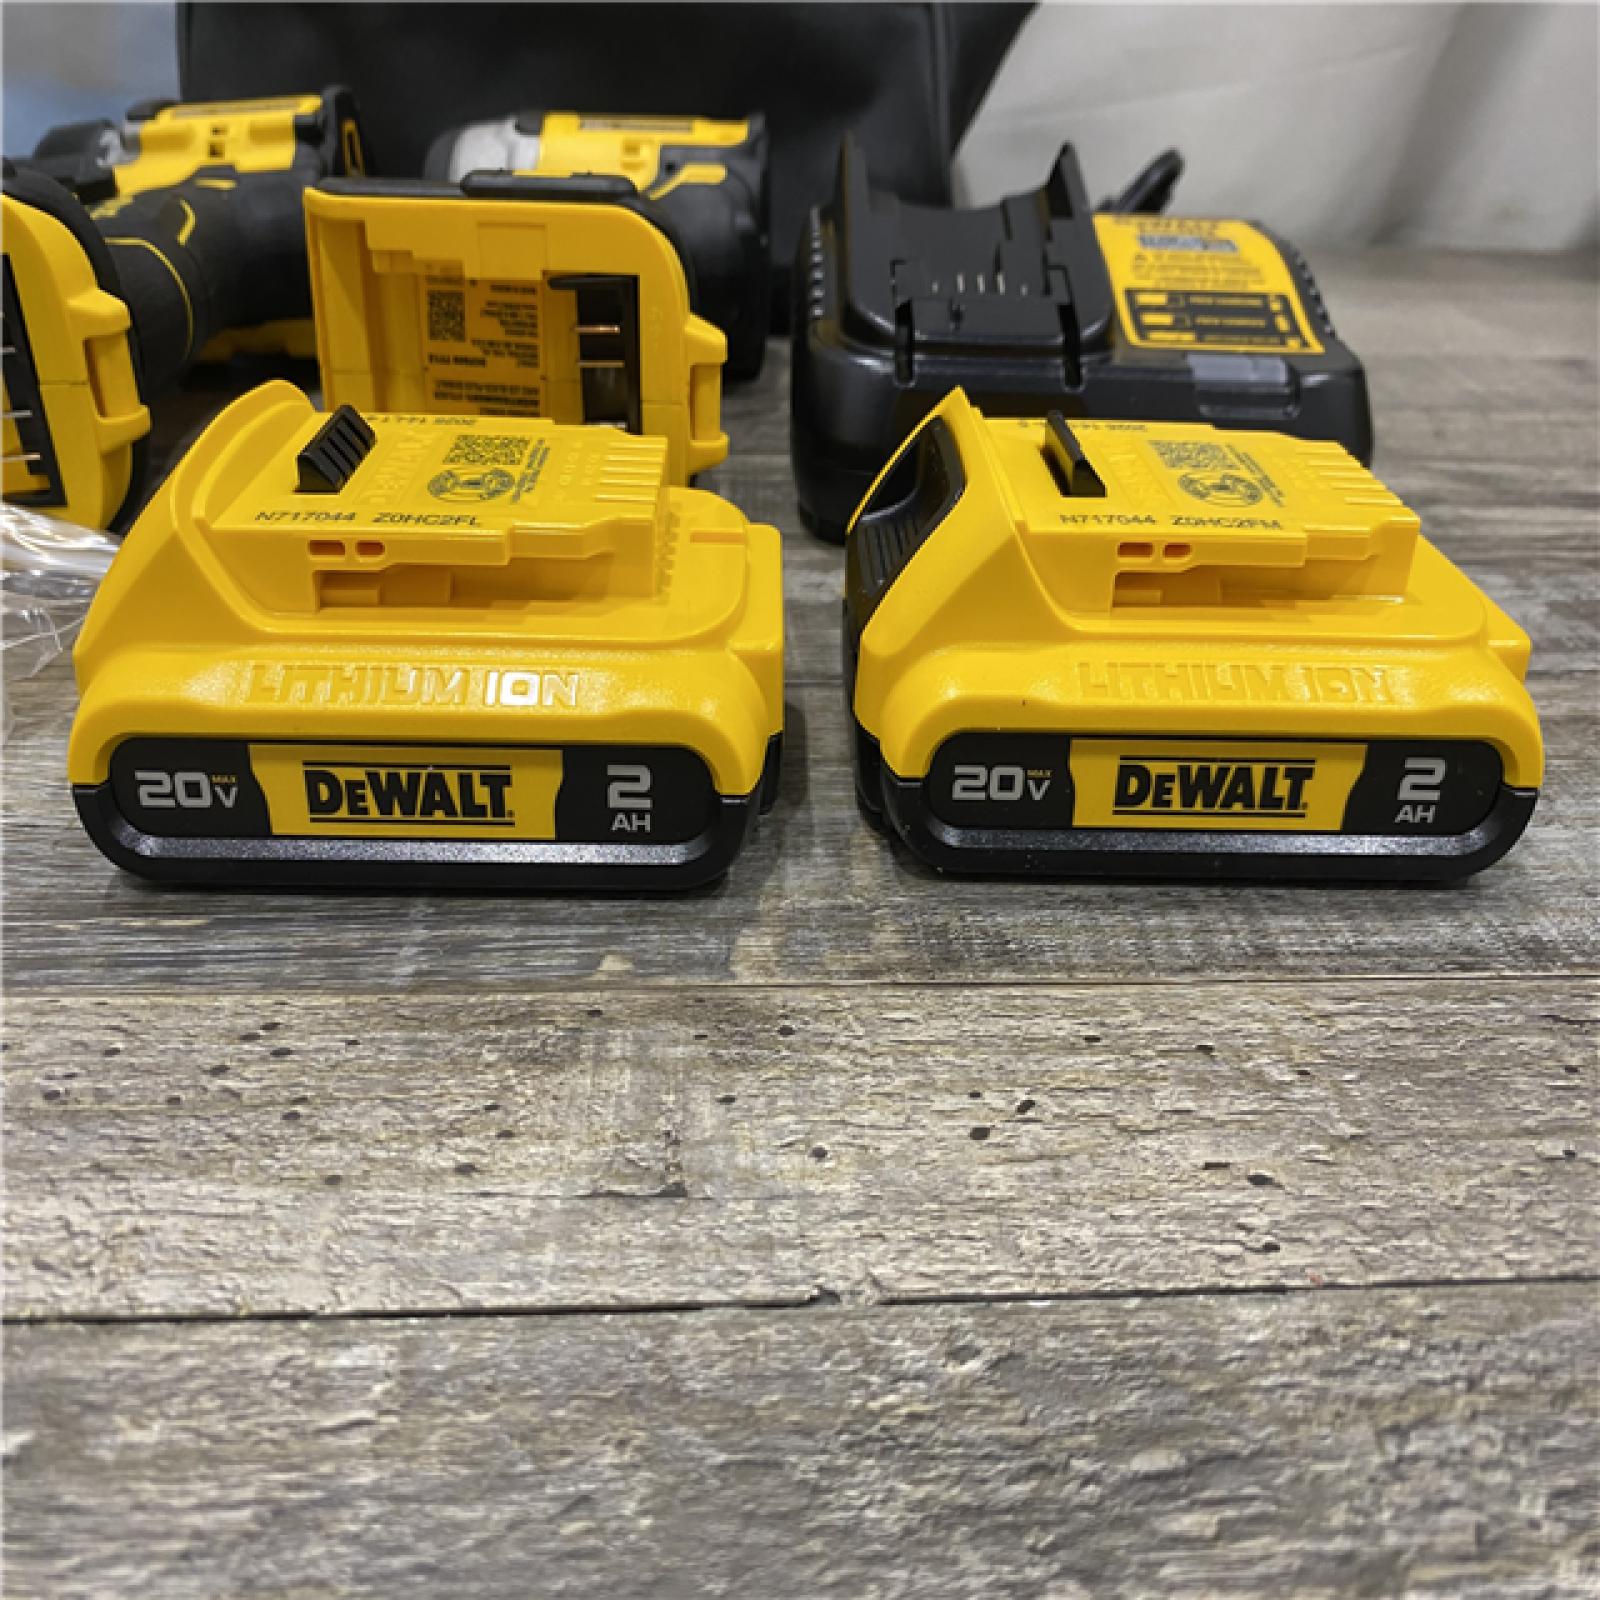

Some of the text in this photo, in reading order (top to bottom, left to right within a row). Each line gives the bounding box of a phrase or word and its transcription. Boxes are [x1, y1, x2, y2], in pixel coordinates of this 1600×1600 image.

[255, 510, 358, 522] N717044
[247, 664, 579, 706] LITHIUM ION
[1077, 661, 1394, 703] LITHIUM ION
[606, 764, 652, 809] 2
[1397, 757, 1446, 801] 2
[611, 811, 651, 833] AH
[1394, 804, 1436, 824] AH
